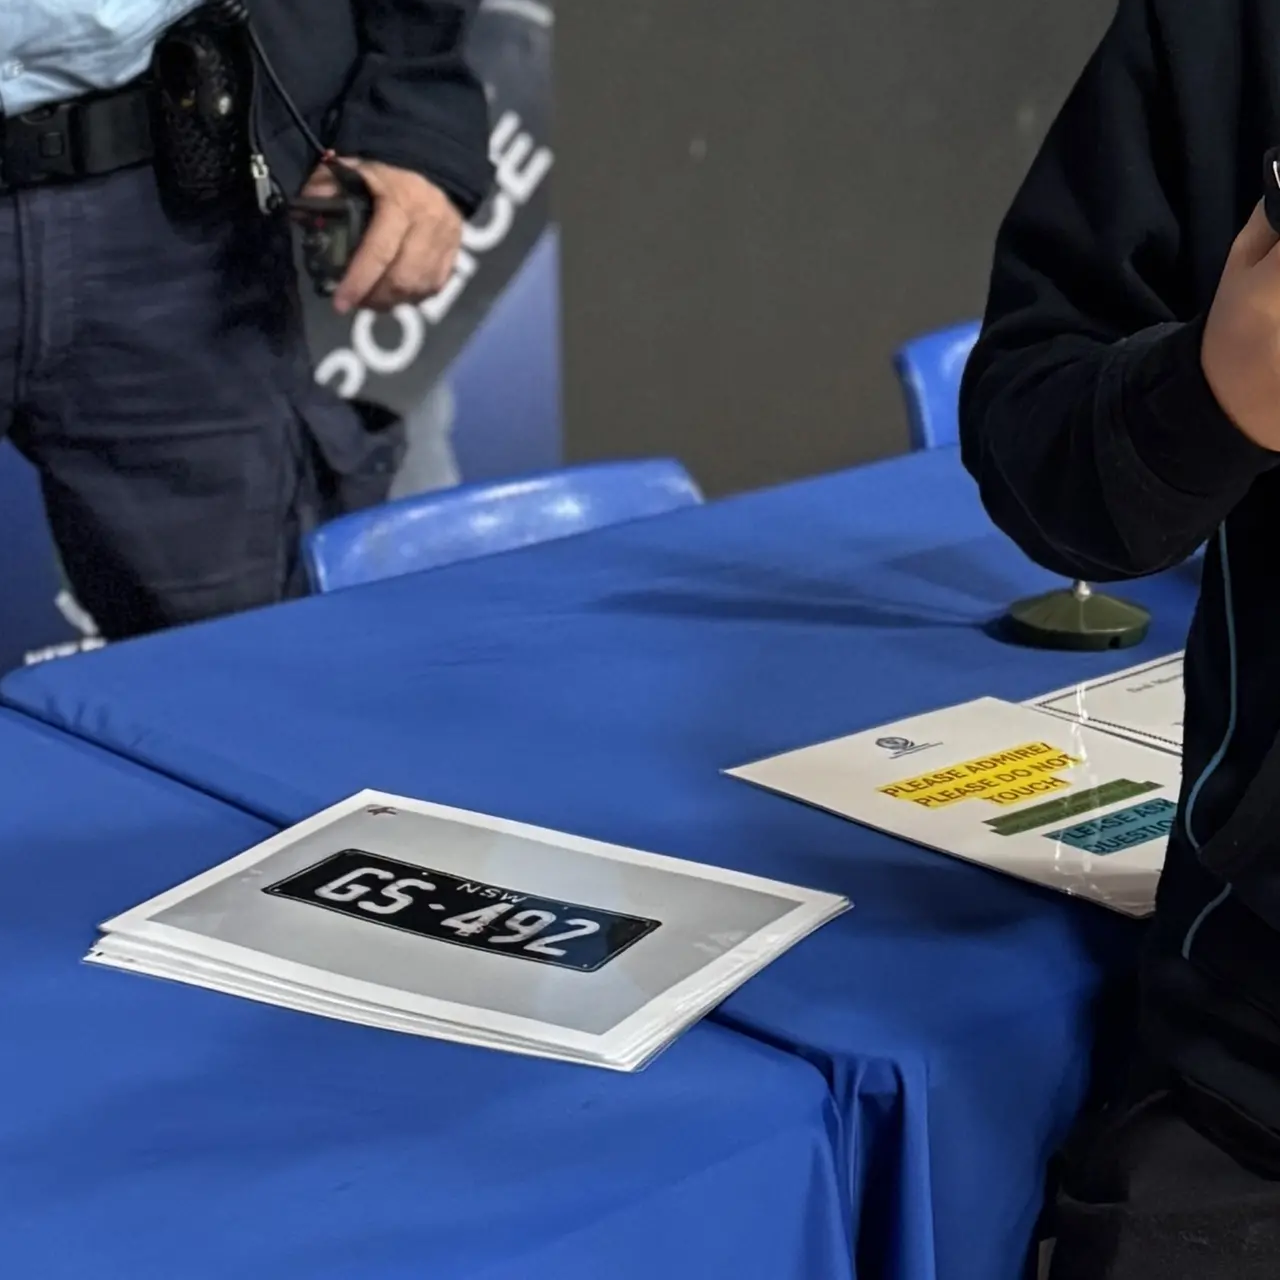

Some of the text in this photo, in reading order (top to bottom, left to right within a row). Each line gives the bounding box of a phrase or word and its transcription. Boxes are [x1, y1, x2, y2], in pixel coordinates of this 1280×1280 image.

[879, 767, 968, 798] PLEASE
[912, 753, 1079, 808] PLEASE DO NOT
[983, 776, 1068, 805] TOUCH
[456, 881, 525, 905] NSW
